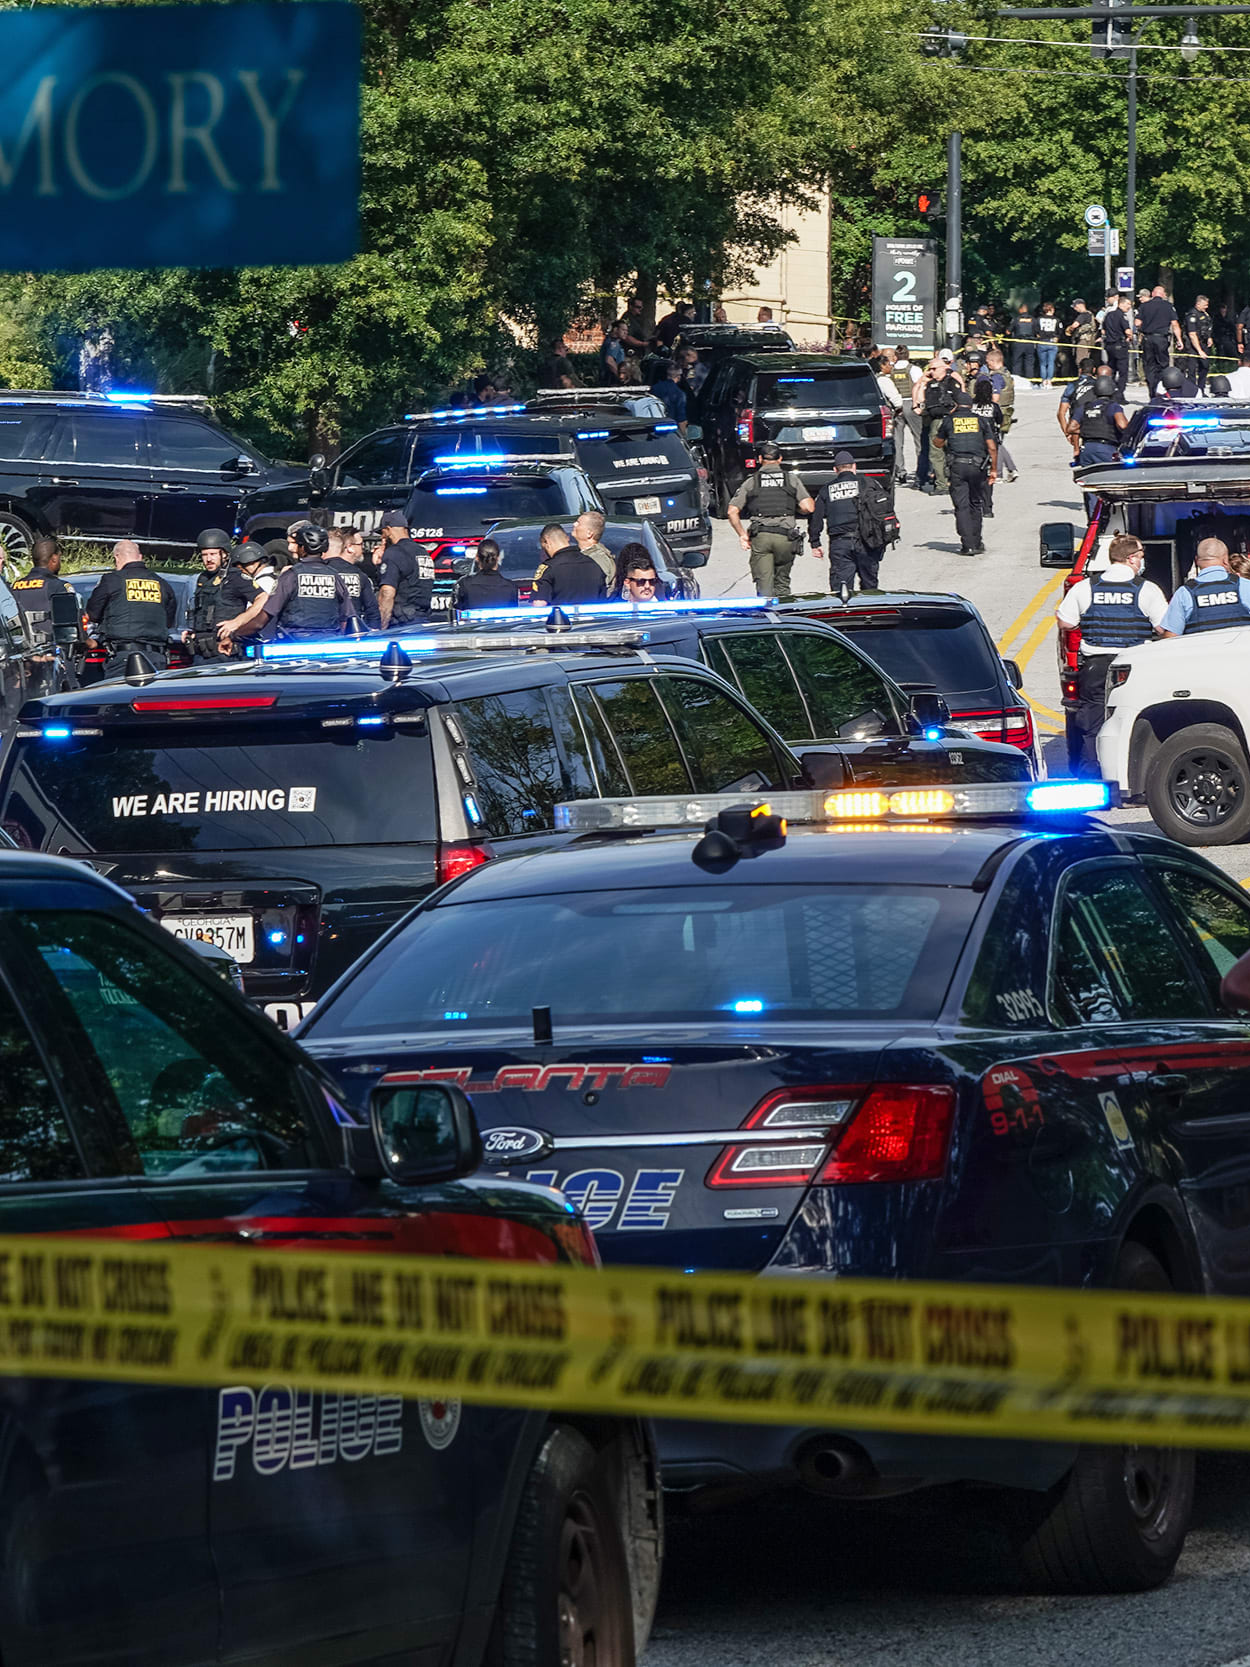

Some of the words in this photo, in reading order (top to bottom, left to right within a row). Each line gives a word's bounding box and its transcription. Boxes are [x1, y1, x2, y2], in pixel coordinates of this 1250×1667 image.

[892, 270, 916, 302] 2
[885, 311, 923, 323] FREE
[885, 323, 923, 332] PARKING
[666, 517, 699, 533] POLICE
[12, 579, 45, 590] POLICE
[127, 580, 160, 592] ATLANTA
[300, 574, 335, 587] ATLANTA
[128, 590, 161, 602] POLICE
[299, 586, 335, 597] POLICE
[1093, 592, 1134, 605] EMS
[1197, 591, 1238, 607] EMS
[112, 794, 149, 818] WE
[150, 791, 200, 815] ARE
[204, 789, 285, 812] HIRING
[182, 918, 231, 927] GEORGIA
[991, 1070, 1019, 1085] DIAL
[990, 1103, 1045, 1136] 9-1-1
[485, 1131, 527, 1151] Ford
[252, 1264, 329, 1323] POLICE
[485, 1276, 569, 1341] CROSS
[655, 1287, 743, 1351] POLICE
[922, 1302, 1014, 1370] CROSS
[1116, 1310, 1216, 1382] POLICE
[213, 1382, 404, 1481] POLICE
